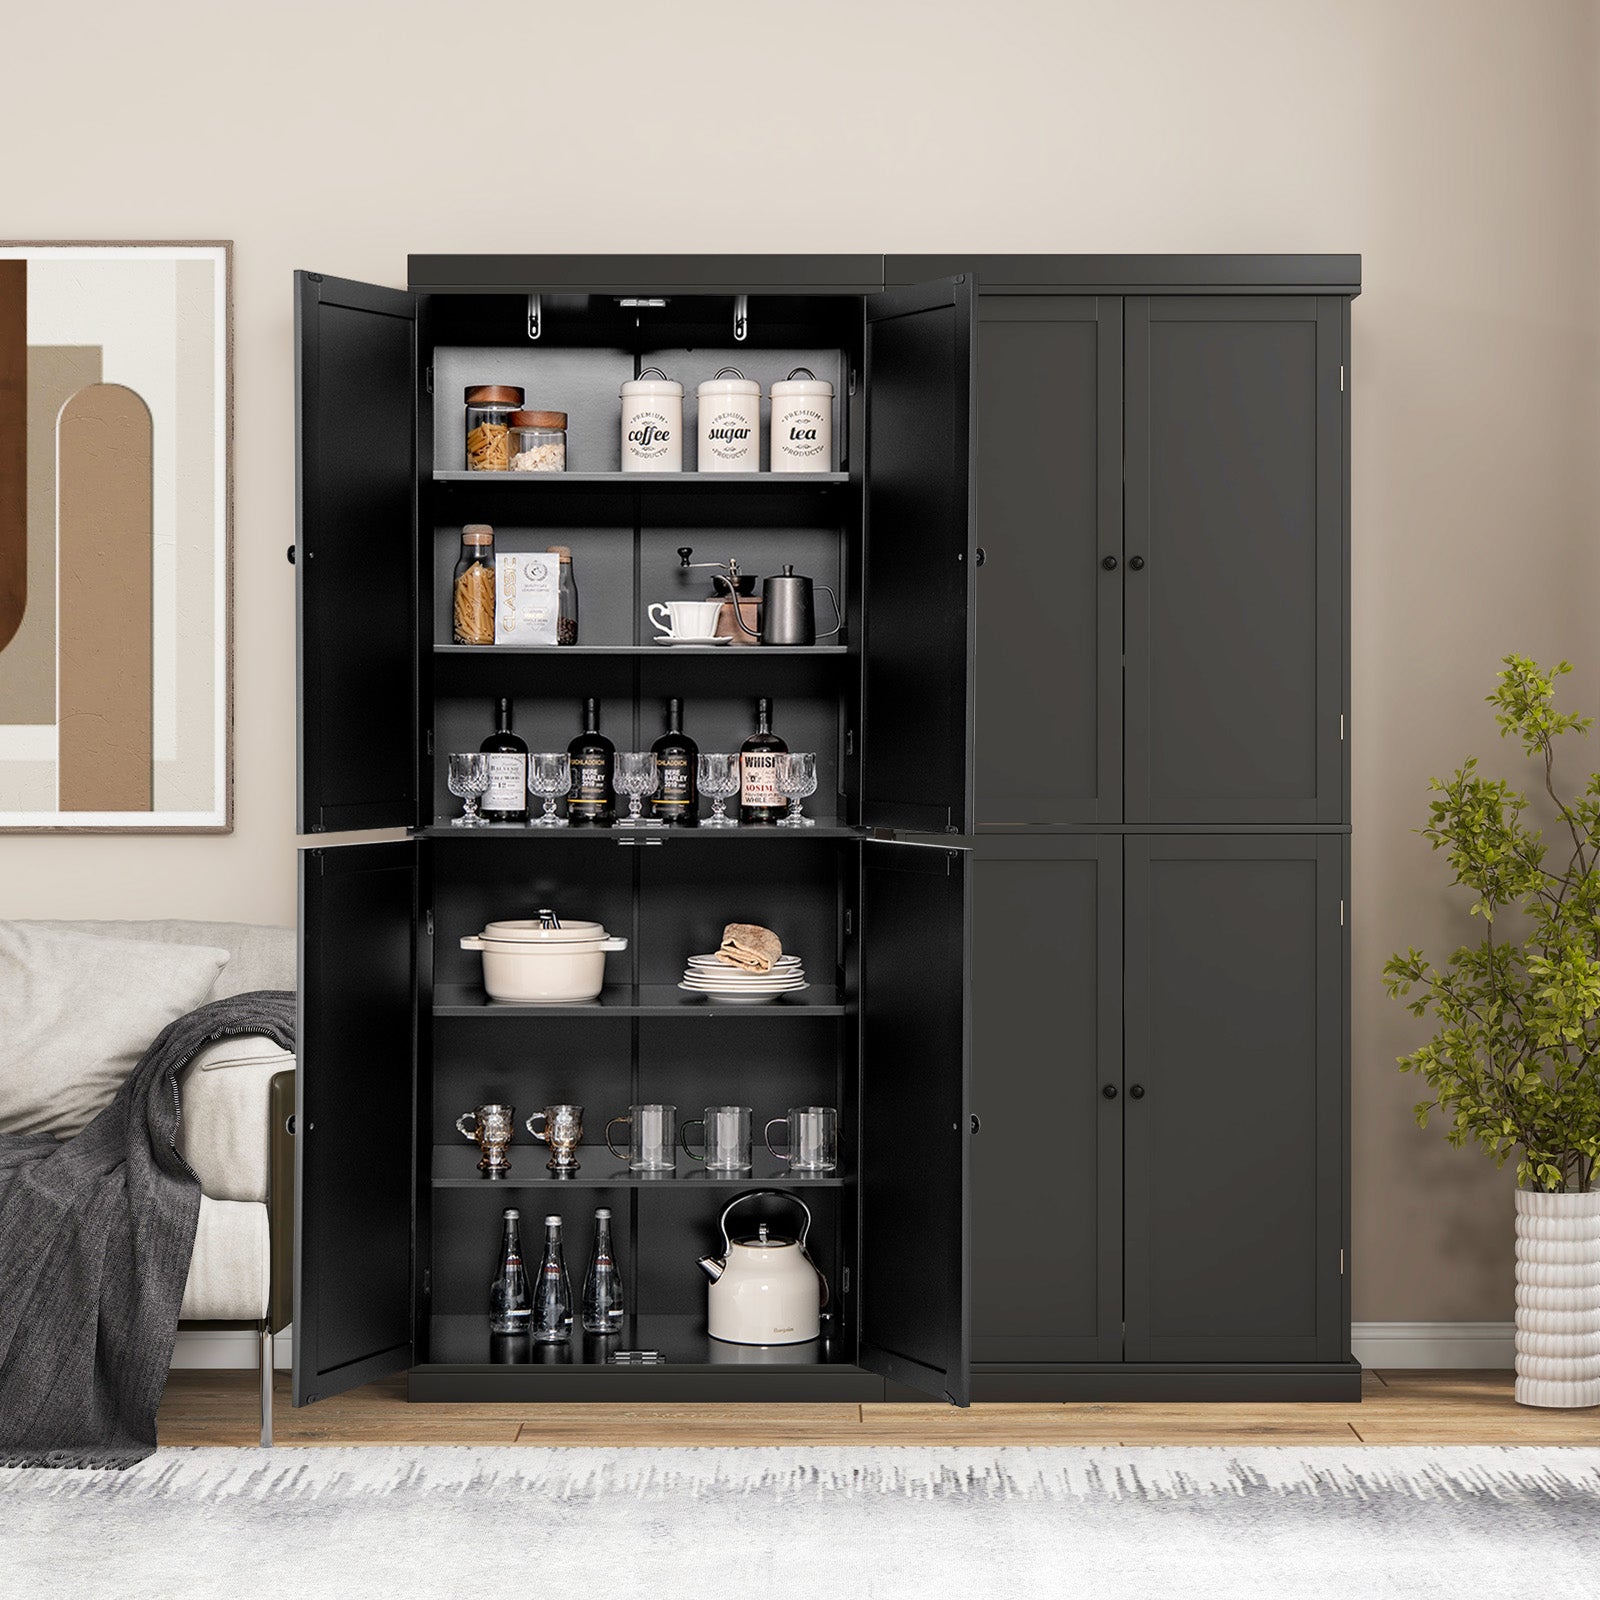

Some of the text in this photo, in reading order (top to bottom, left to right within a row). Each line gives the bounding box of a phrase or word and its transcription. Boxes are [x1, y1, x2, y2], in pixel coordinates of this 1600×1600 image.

[632, 411, 666, 422] PREMIUM
[714, 412, 746, 422] PREMIUM
[784, 410, 822, 421] PREMIUM
[628, 425, 671, 446] coffee
[708, 428, 752, 444] sugar
[789, 426, 817, 441] tea
[631, 447, 667, 459] PRODUCTS
[713, 448, 747, 459] PRODUCTS
[784, 445, 824, 457] PRODUCTS
[503, 557, 517, 633] CLASSIC
